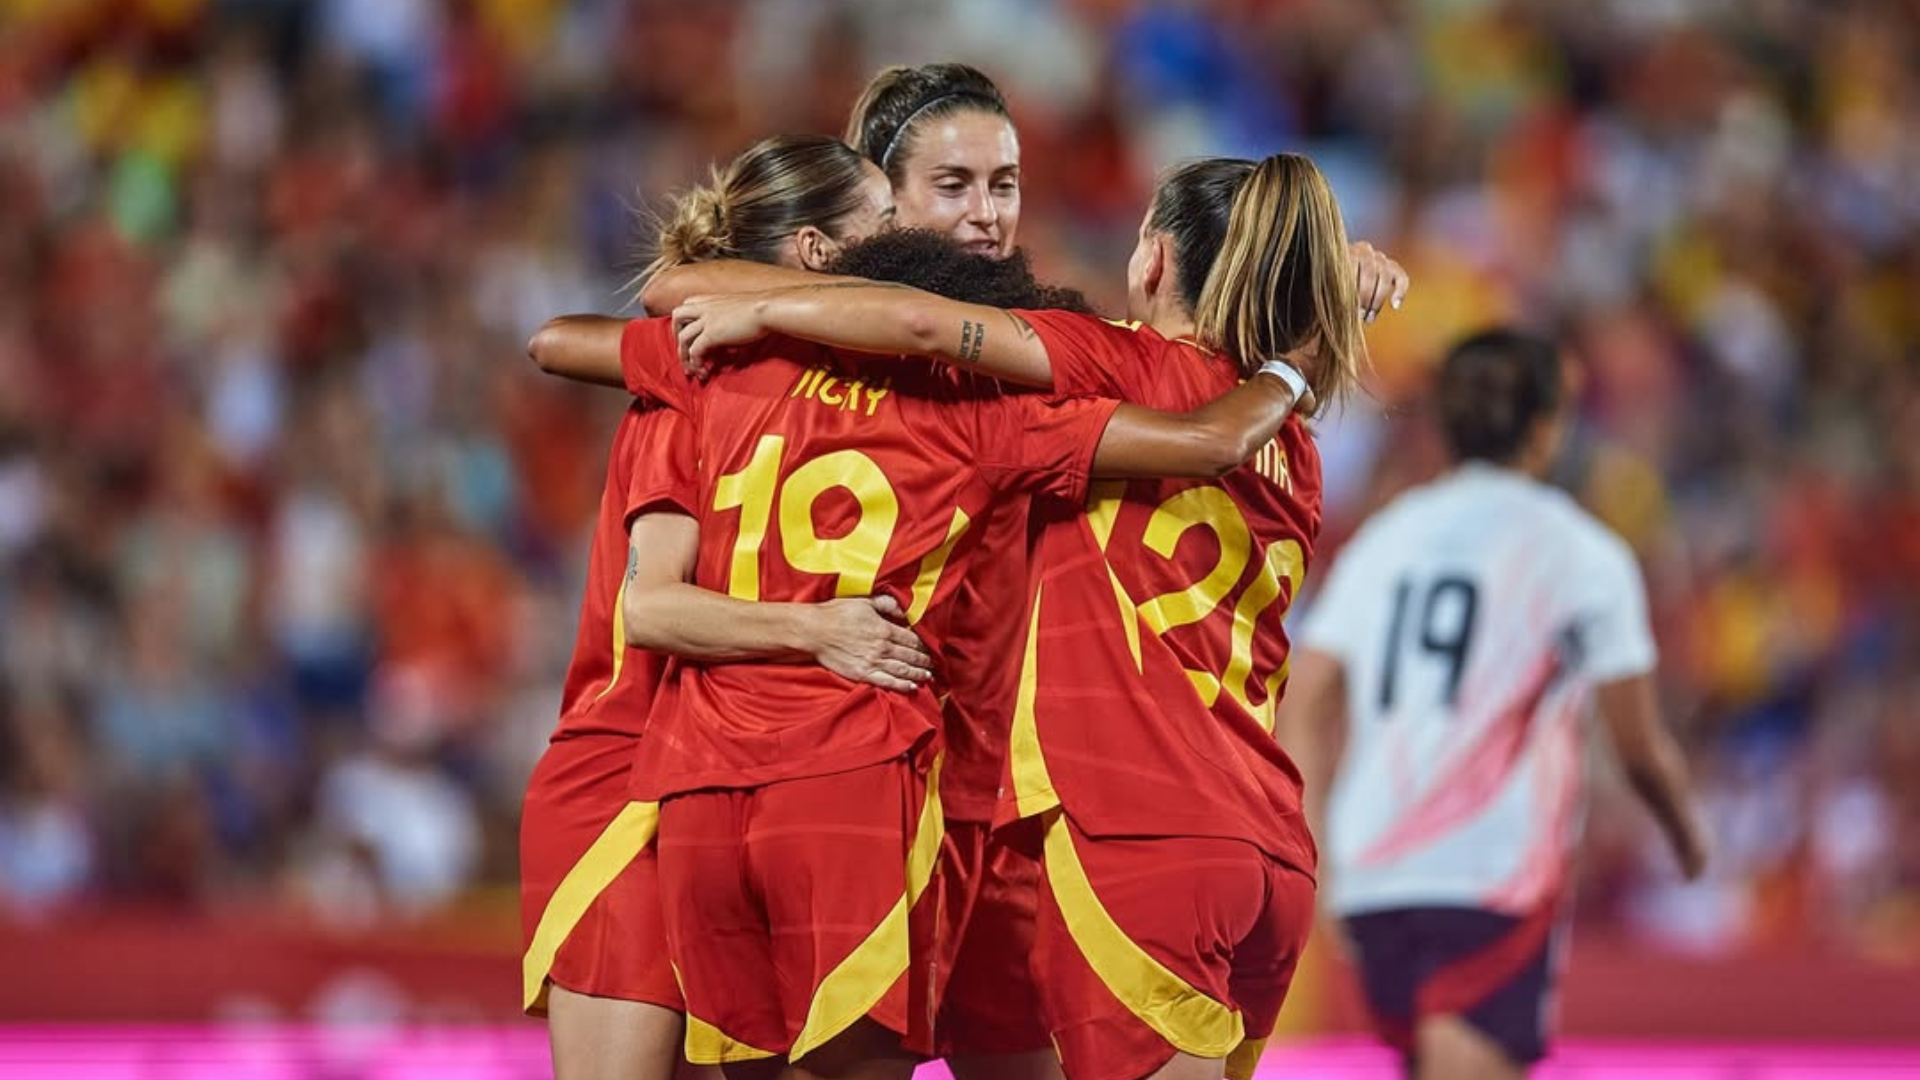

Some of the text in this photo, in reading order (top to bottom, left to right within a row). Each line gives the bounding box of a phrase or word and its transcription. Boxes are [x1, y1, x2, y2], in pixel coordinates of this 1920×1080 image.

[712, 434, 899, 602] 19
[1136, 486, 1307, 735] 20
[1378, 573, 1479, 710] 19
